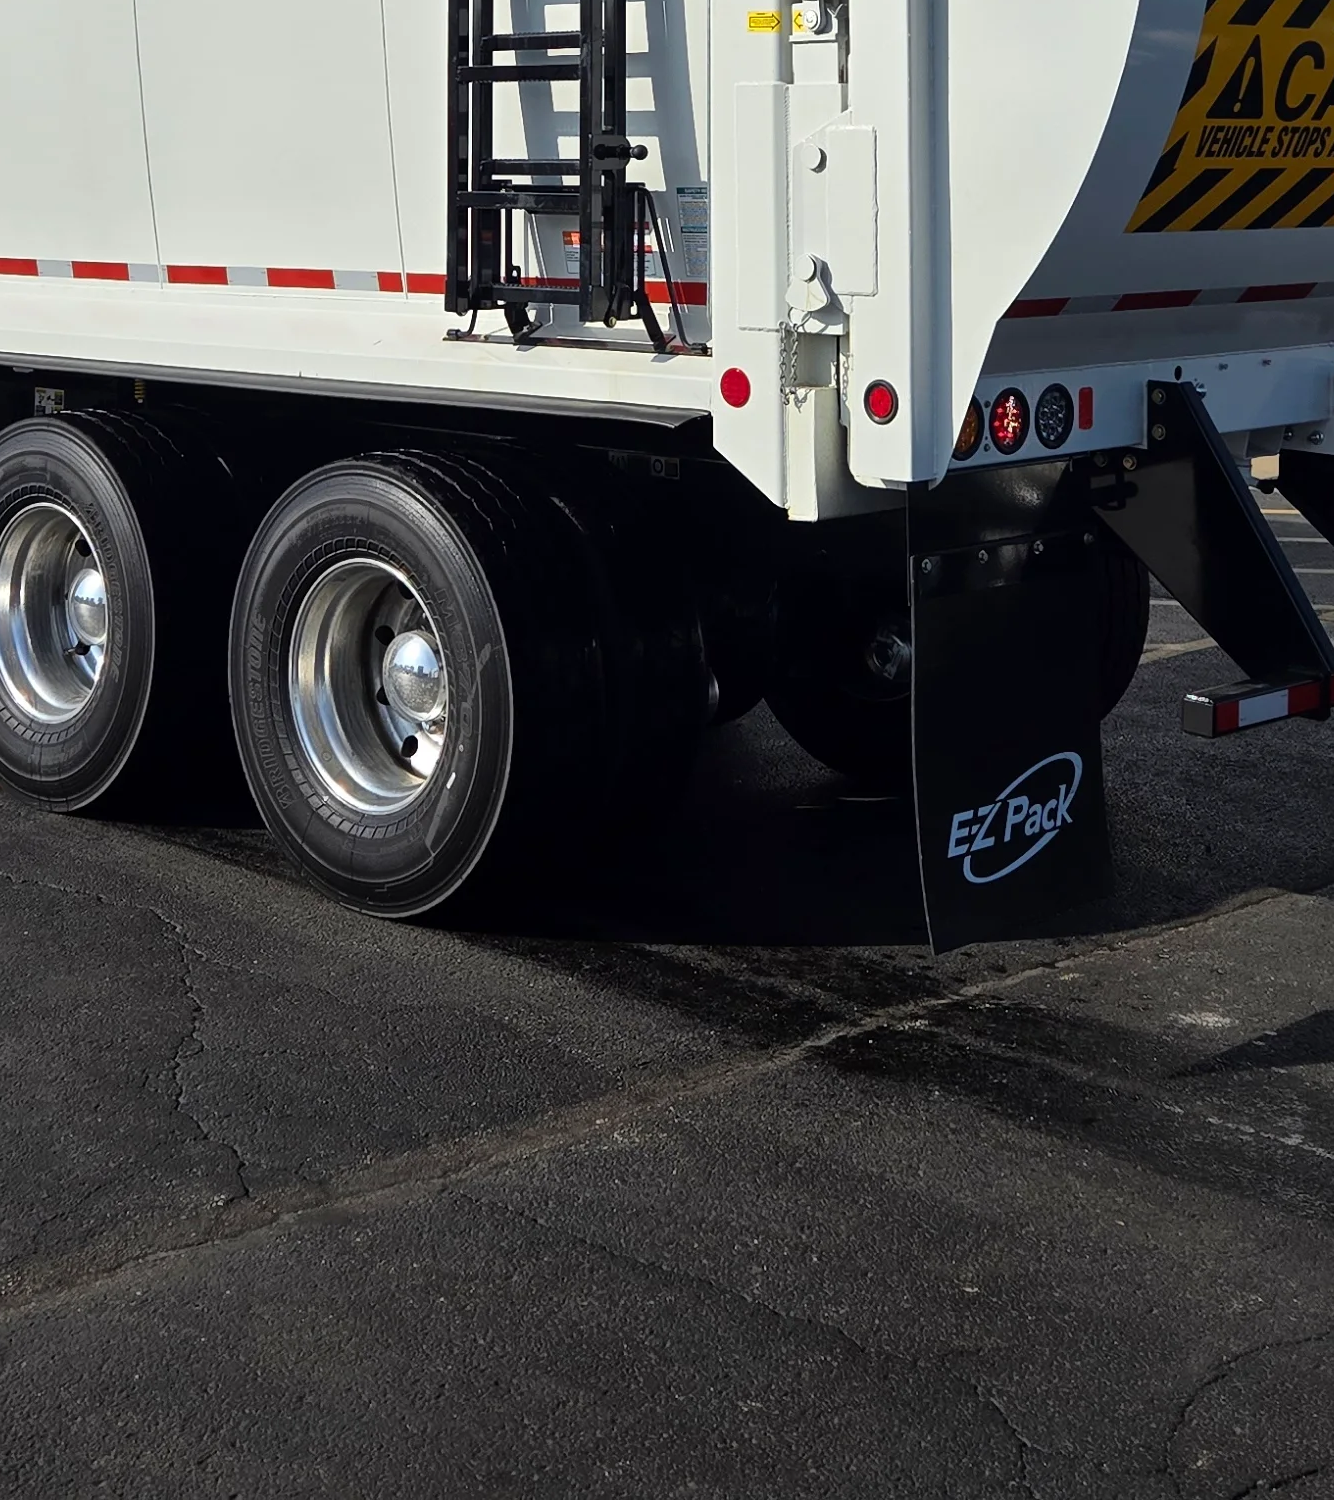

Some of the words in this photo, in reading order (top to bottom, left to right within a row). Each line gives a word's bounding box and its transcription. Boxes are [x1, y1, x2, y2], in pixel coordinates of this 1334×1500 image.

[1195, 125, 1275, 158] VEHICLE
[1271, 126, 1331, 158] STOPS
[1004, 784, 1073, 842] Pack
